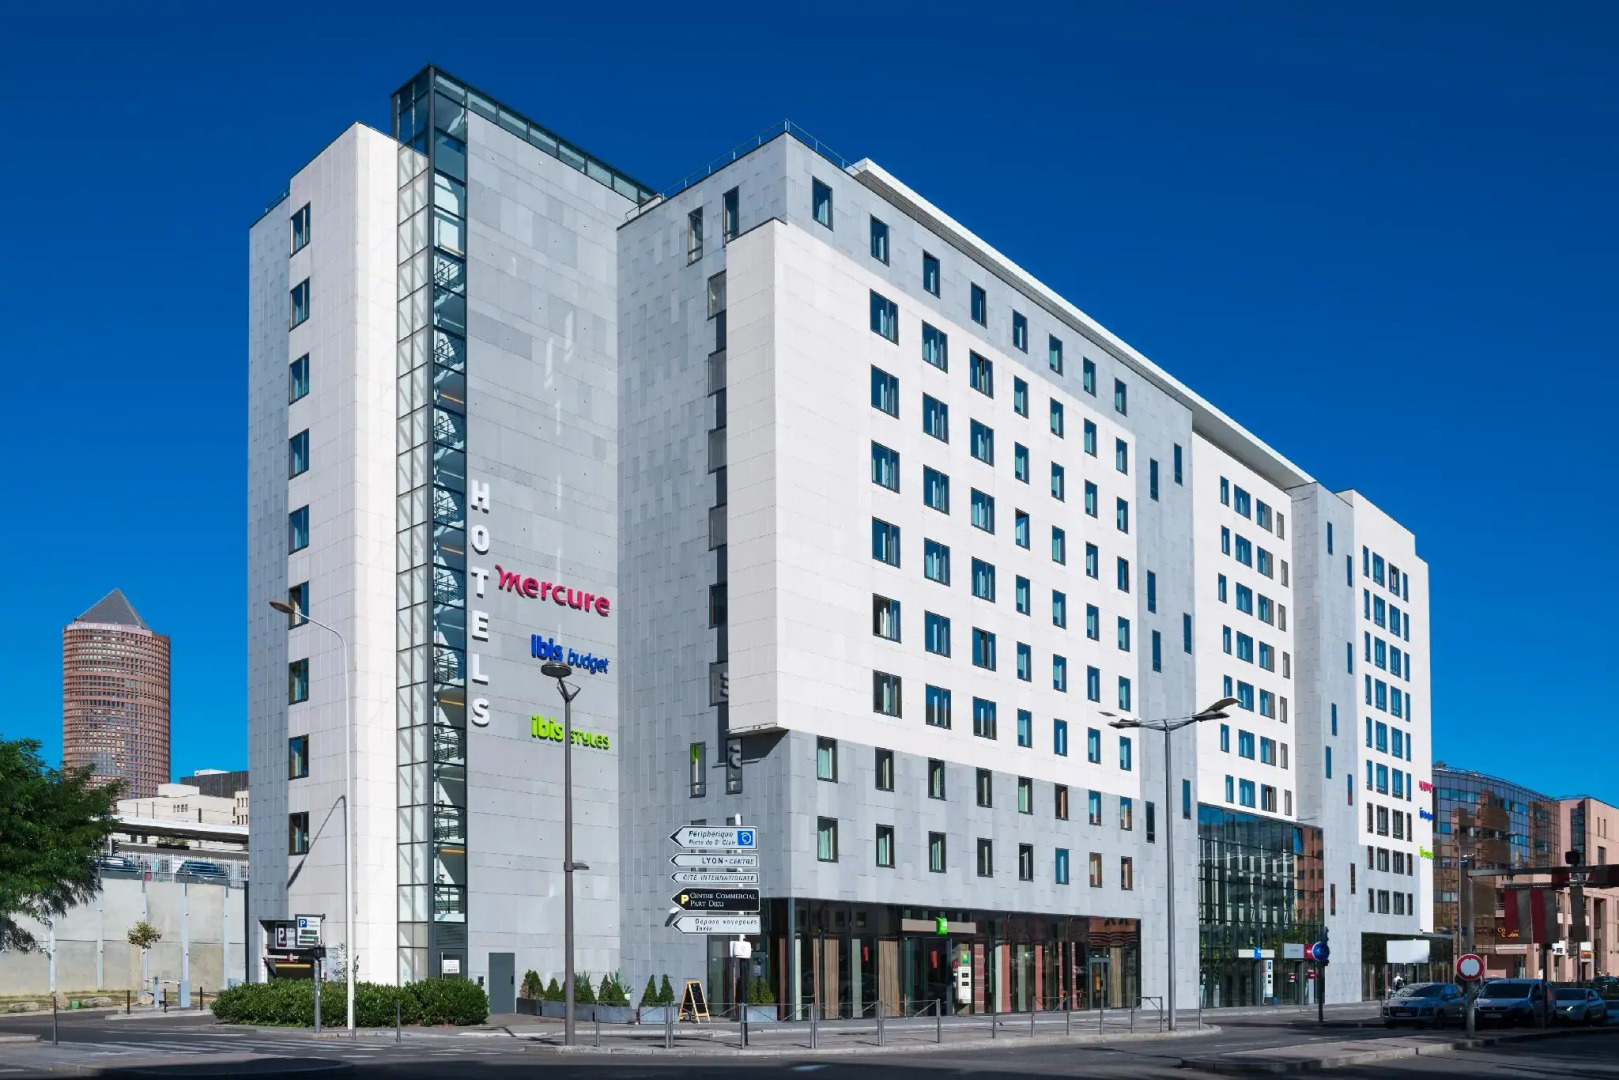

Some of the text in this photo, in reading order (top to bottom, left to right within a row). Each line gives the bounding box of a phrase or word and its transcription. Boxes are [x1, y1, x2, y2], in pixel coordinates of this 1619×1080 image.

[471, 479, 490, 728] HOTELS
[495, 563, 611, 617] mercure
[531, 633, 610, 675] ibis budget
[531, 714, 564, 742] ibis
[715, 892, 757, 900] COMMERCIAL
